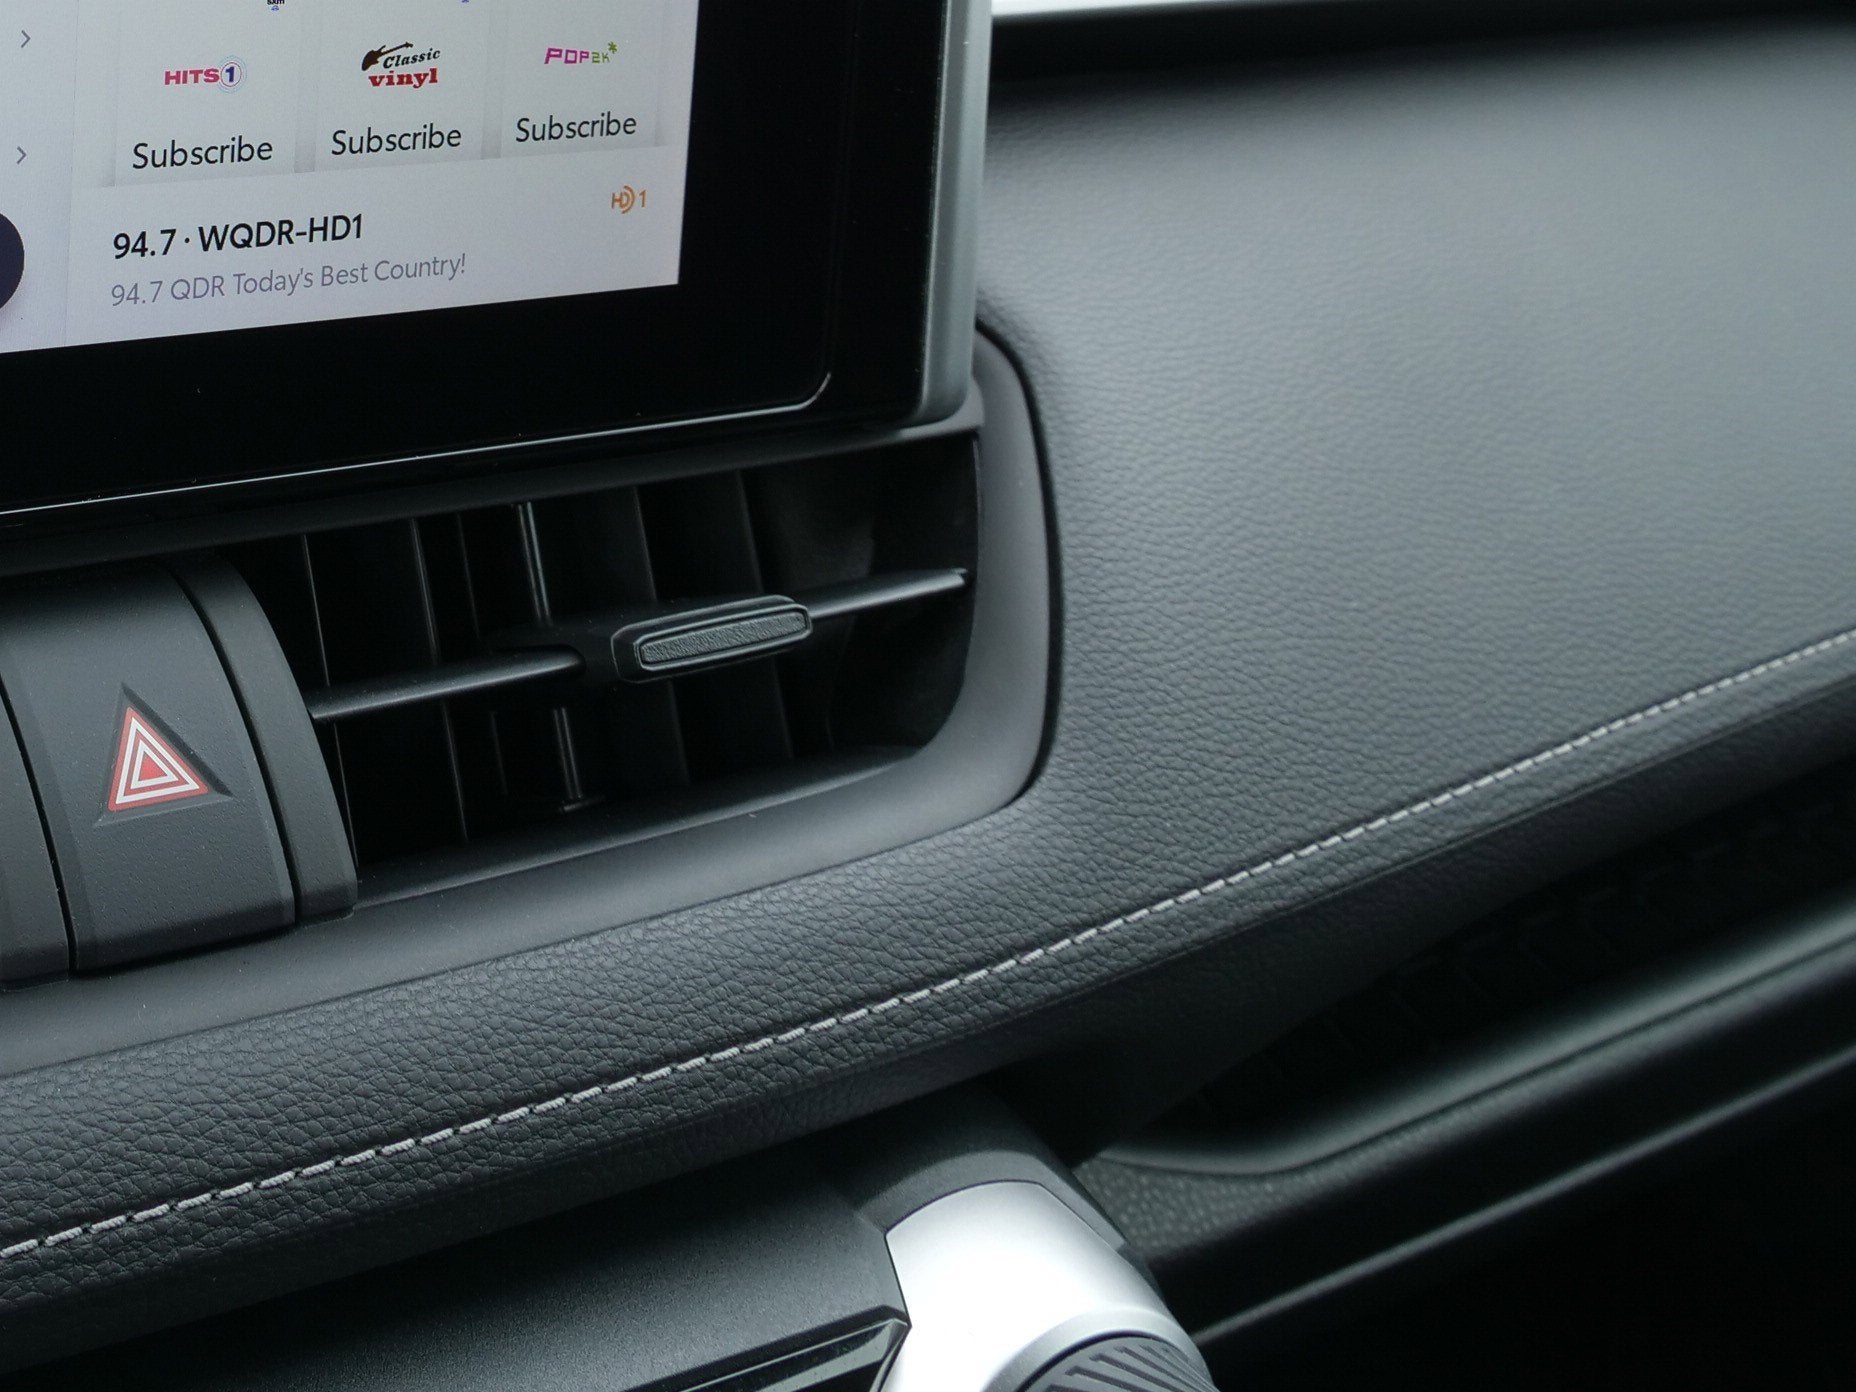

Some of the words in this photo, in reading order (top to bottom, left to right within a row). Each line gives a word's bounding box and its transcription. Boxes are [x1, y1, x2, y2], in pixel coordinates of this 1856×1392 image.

[382, 48, 442, 69] Classic
[164, 67, 220, 86] HITS
[367, 67, 439, 89] vinyl
[331, 122, 462, 156] Subscribe
[515, 110, 637, 143] Subscribe
[132, 135, 273, 170] Subscribe
[113, 228, 177, 260] 94.7
[197, 213, 362, 252] WQDR-HD1
[111, 280, 164, 307] 94.7
[170, 275, 225, 301] QDR
[232, 267, 314, 297] Today's
[320, 262, 369, 287] Best
[374, 252, 466, 282] Country!
